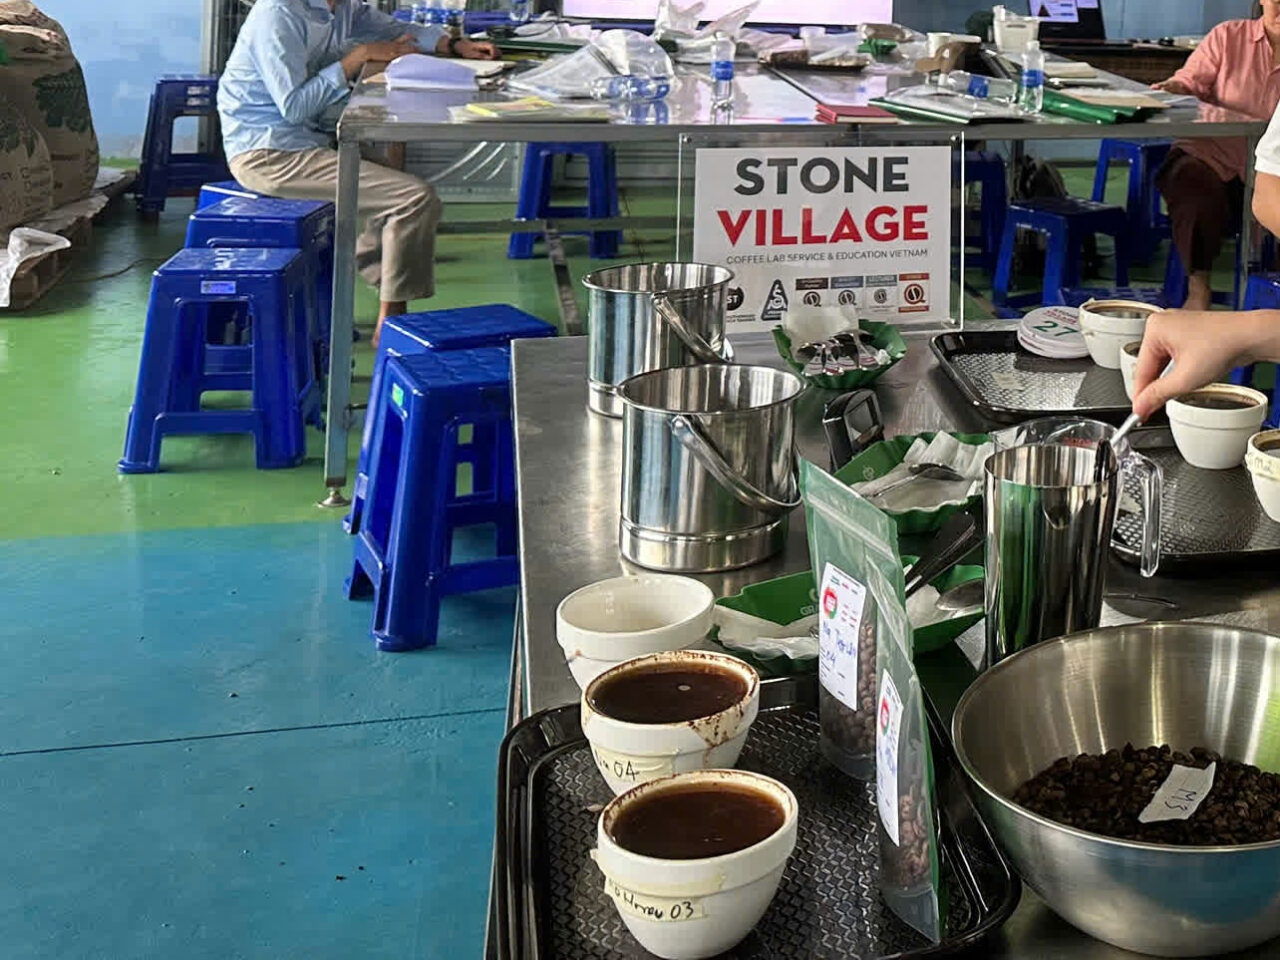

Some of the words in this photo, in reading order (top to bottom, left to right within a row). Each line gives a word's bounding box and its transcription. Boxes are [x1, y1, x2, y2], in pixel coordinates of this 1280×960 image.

[734, 156, 910, 196] STONE
[717, 205, 929, 247] VILLAGE
[726, 254, 764, 265] COFFEE
[767, 254, 785, 263] LAB
[788, 253, 825, 263] SERVICE
[836, 250, 888, 260] EDUCATION
[889, 248, 928, 259] VIETNAM
[727, 294, 739, 305] ST
[1033, 321, 1079, 337] 27
[614, 760, 640, 781] 04
[670, 901, 694, 920] 03
